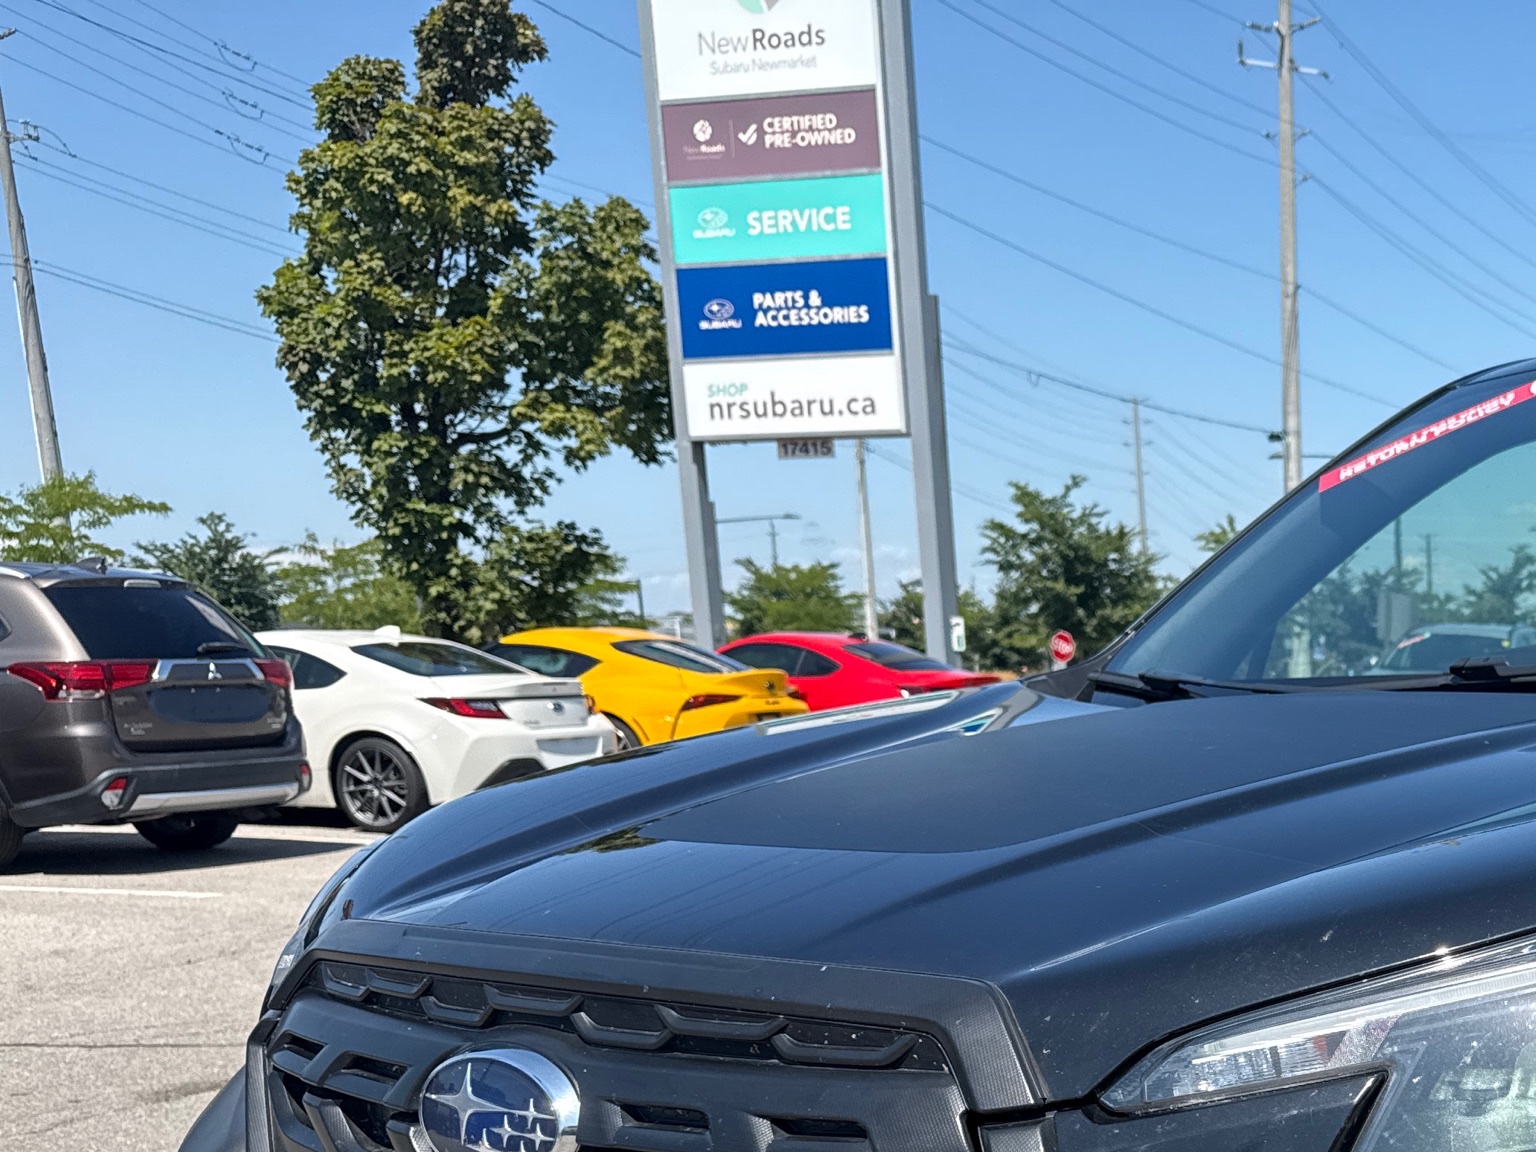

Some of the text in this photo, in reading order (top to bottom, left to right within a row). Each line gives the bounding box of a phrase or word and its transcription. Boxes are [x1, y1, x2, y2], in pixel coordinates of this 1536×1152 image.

[709, 54, 817, 76] Subaru Newmarket
[762, 113, 837, 133] CERTIFIED
[764, 128, 856, 149] PRE-OWNED
[747, 206, 852, 236] SERVICE
[752, 289, 822, 310] PARTS &
[754, 305, 870, 328] ACCESSORIES
[707, 383, 748, 398] SHOP
[709, 391, 877, 421] nrsubaru.ca
[781, 441, 832, 456] 17415
[1051, 637, 1073, 654] STOP
